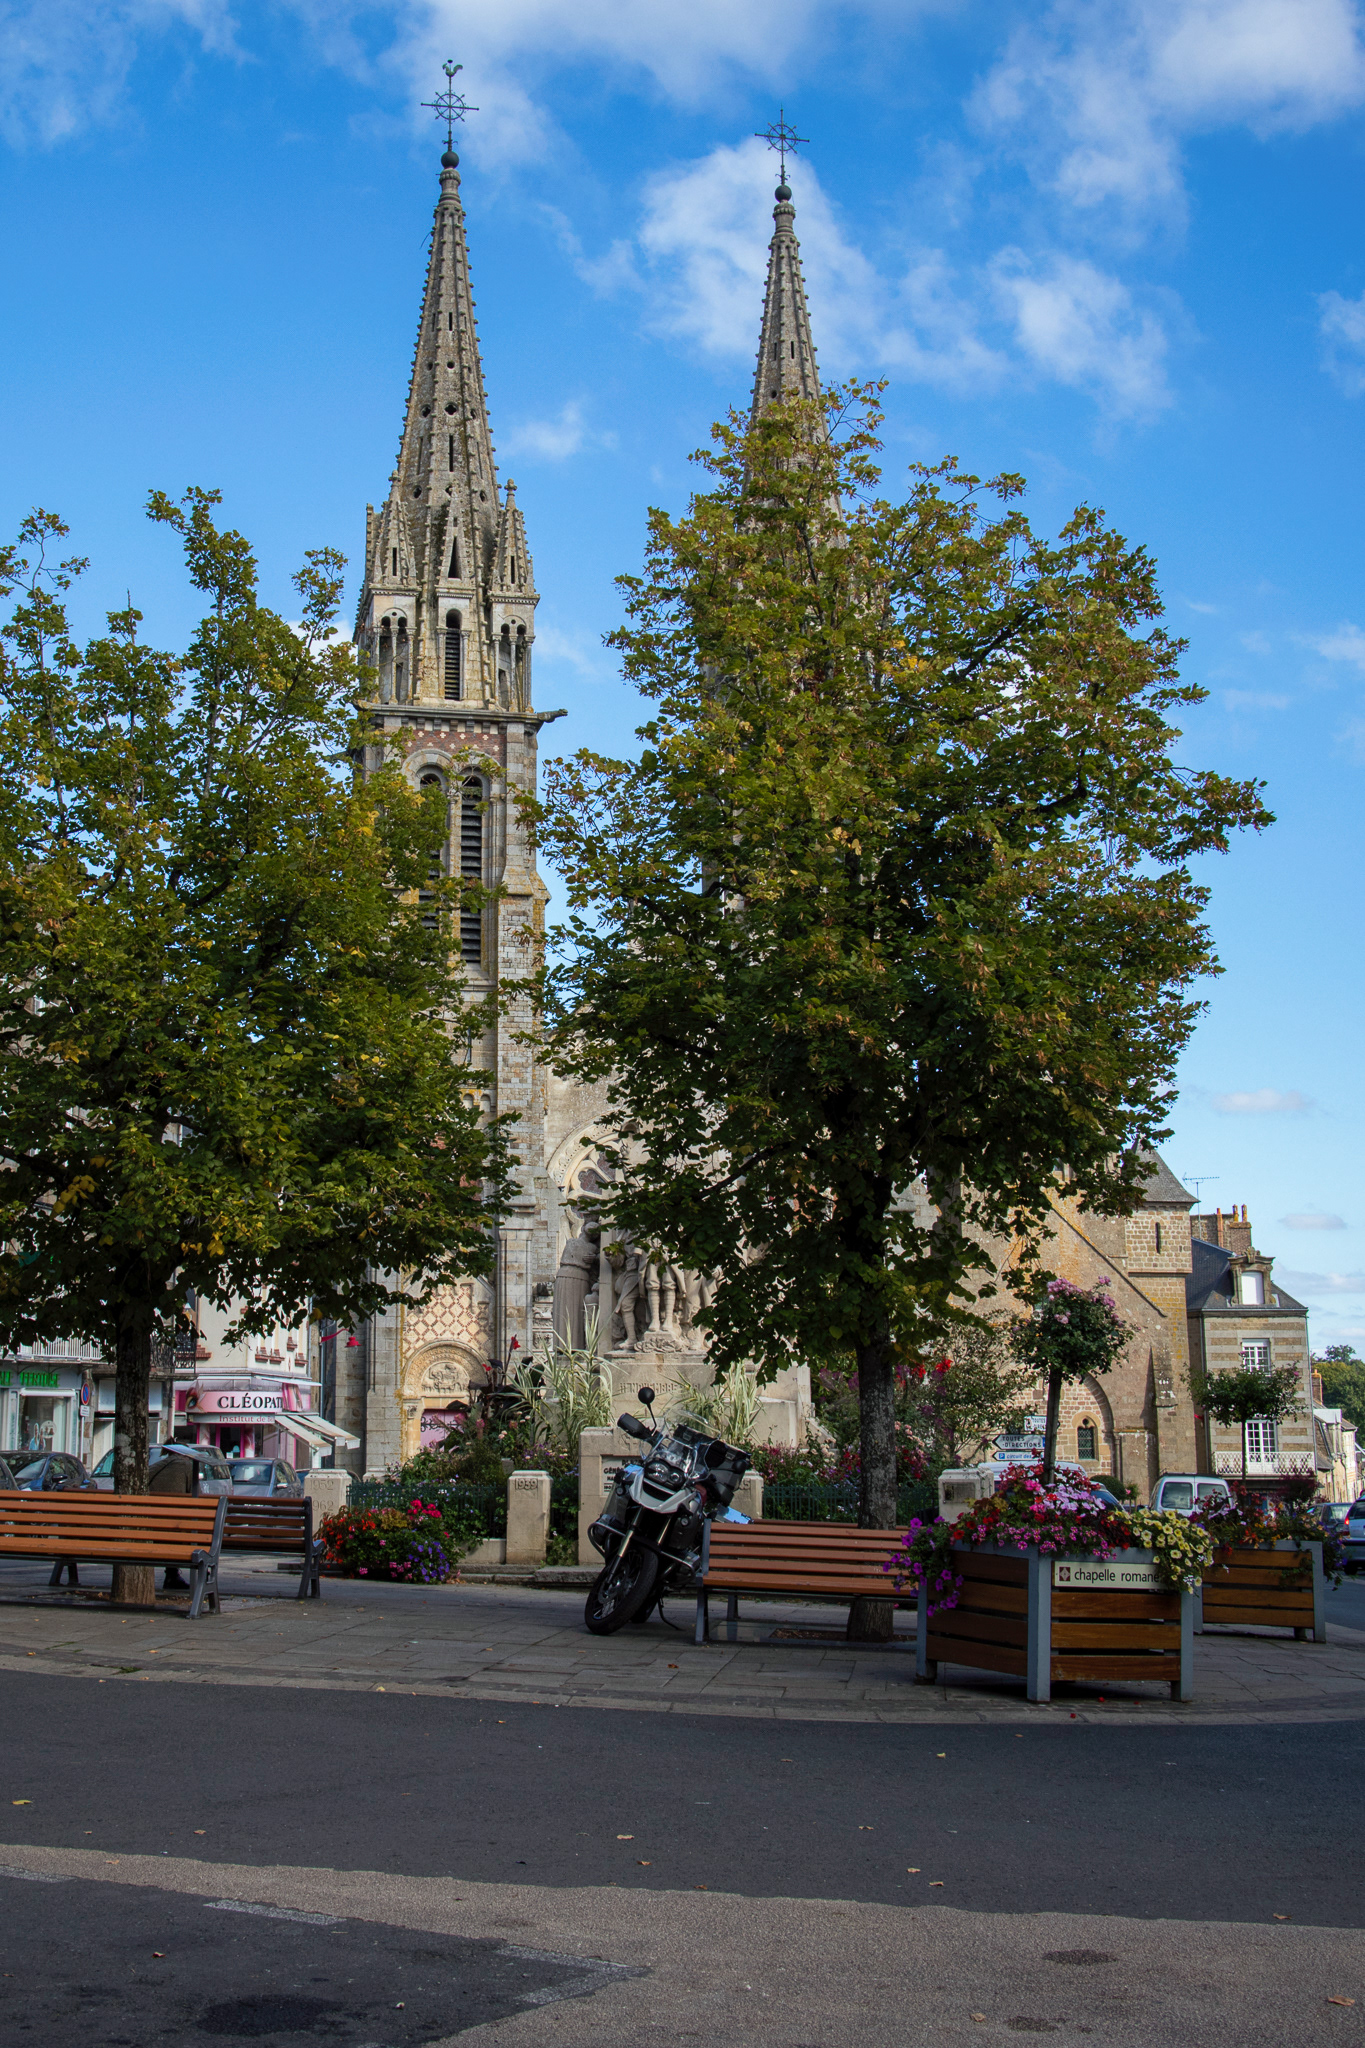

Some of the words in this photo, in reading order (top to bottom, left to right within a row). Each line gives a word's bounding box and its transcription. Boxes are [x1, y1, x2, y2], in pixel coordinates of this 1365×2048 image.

[515, 1477, 539, 1491] 1939
[311, 1499, 334, 1511] 962
[1074, 1567, 1116, 1584] chapelle
[1121, 1572, 1160, 1583] romane
